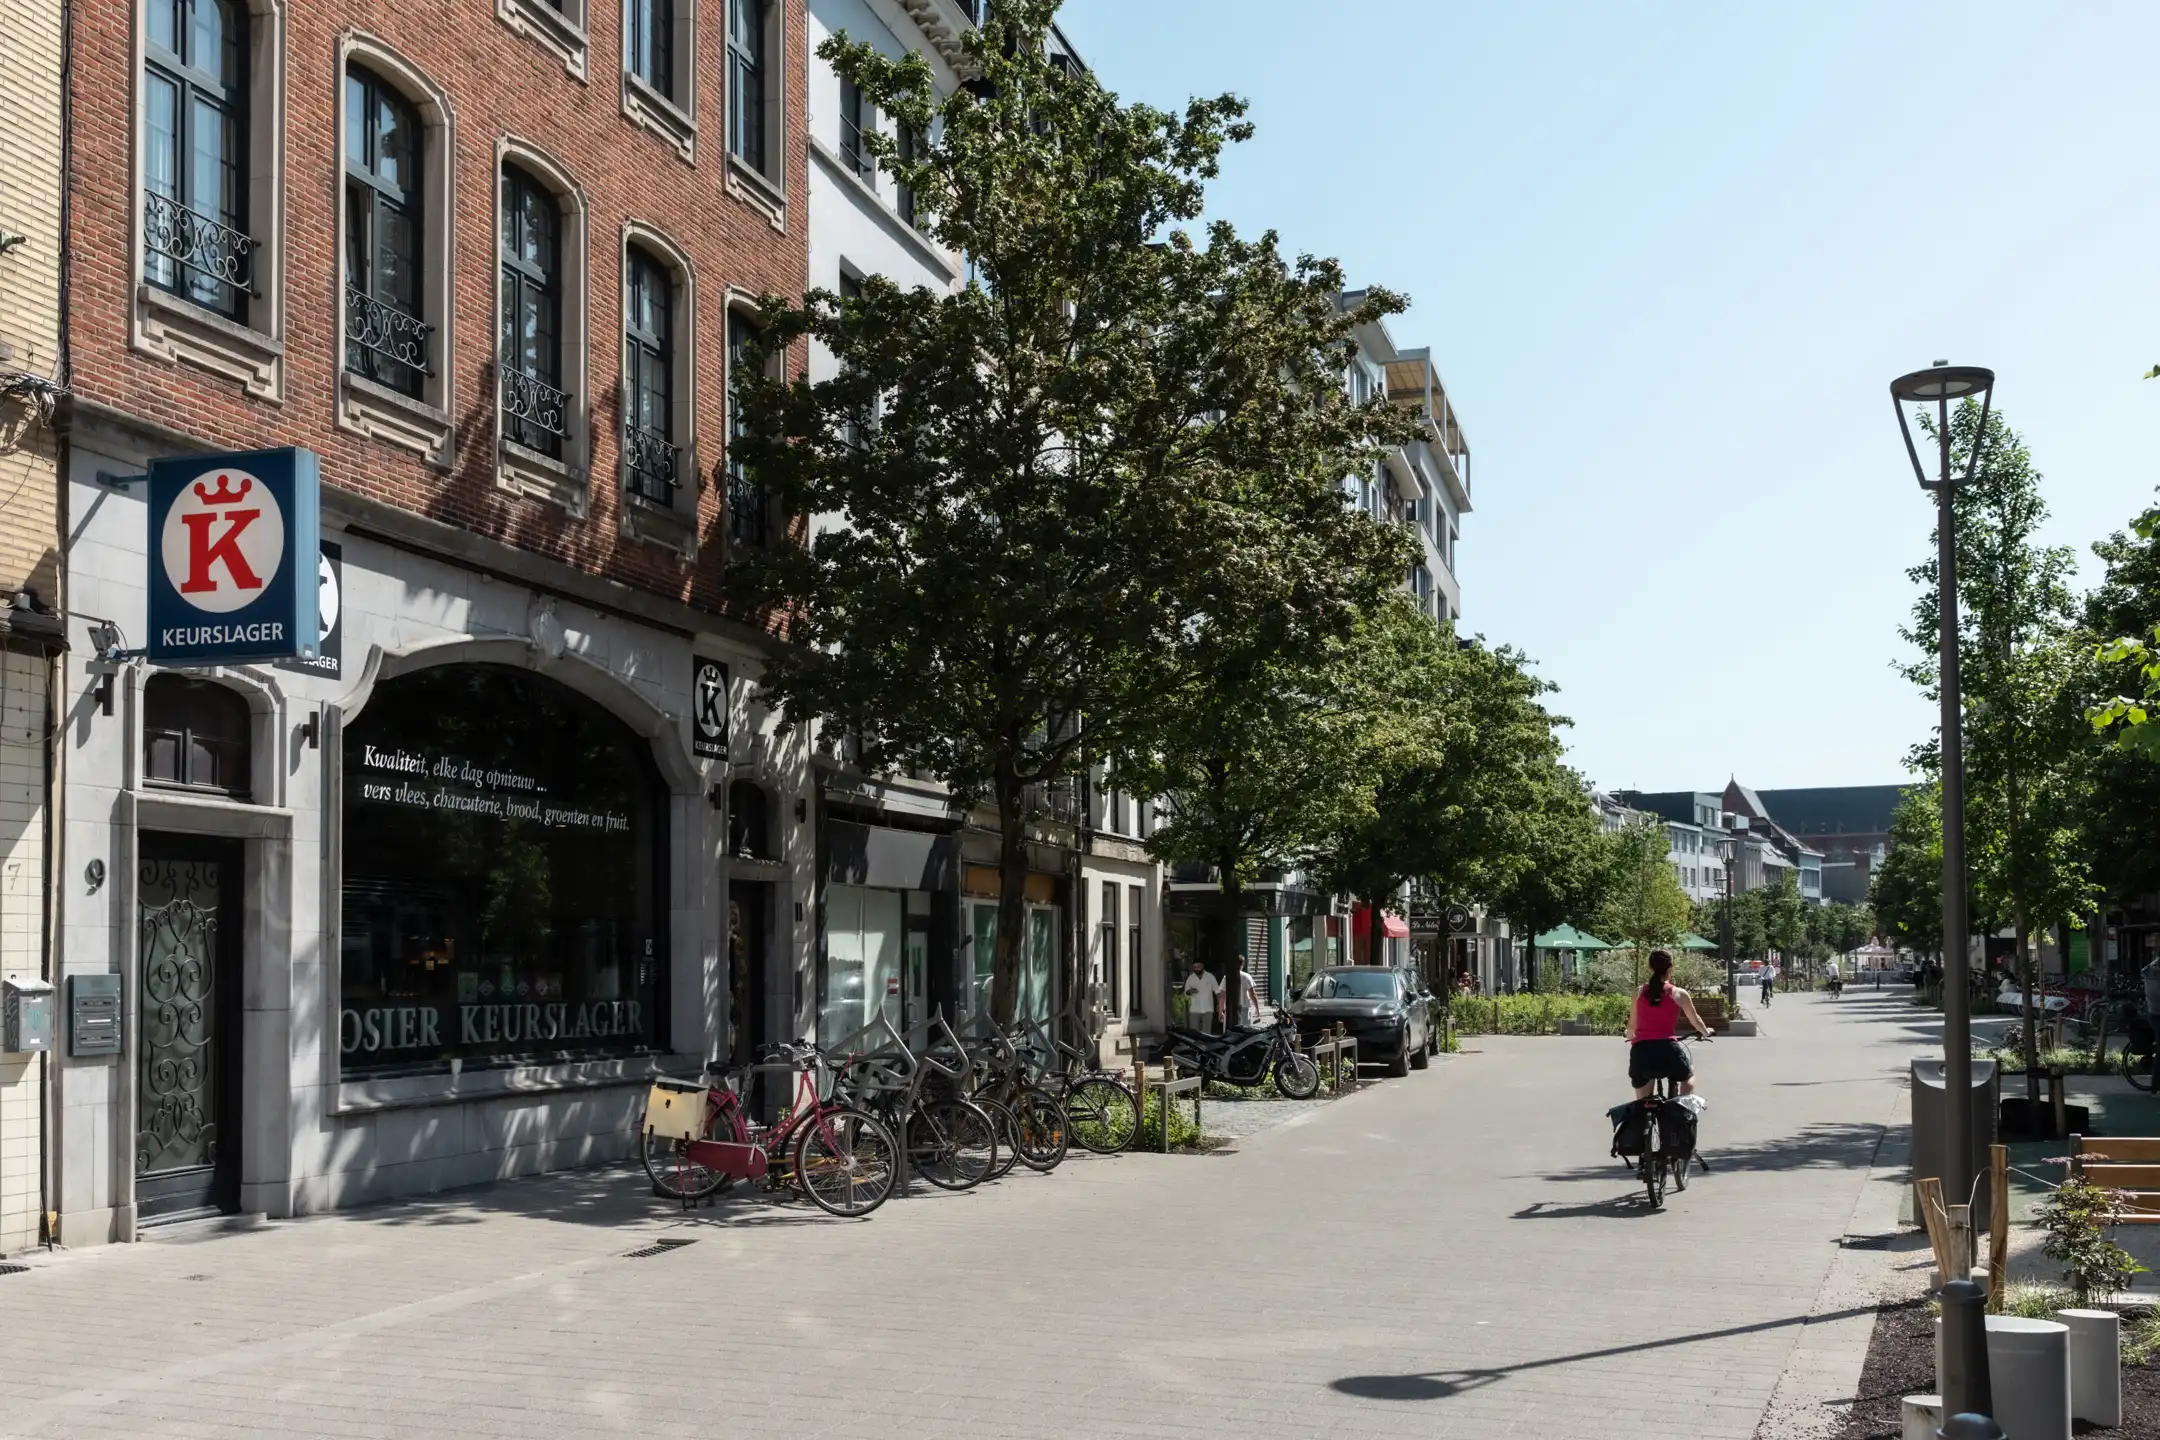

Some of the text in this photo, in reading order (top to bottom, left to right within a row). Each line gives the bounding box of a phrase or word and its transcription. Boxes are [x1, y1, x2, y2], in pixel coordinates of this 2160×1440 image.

[181, 509, 262, 593] K
[162, 622, 284, 647] KEURSLAGER
[700, 683, 722, 728] K
[364, 745, 429, 778] Kwaliteit,
[433, 756, 458, 779] elke
[460, 761, 484, 788] dag
[486, 768, 535, 790] opnieuw
[695, 740, 728, 754] KEURSLAGER
[364, 781, 630, 832] vers vlees, charcuterie, brood, groenten en fruit.
[459, 1001, 643, 1044] KEURSLAGER
